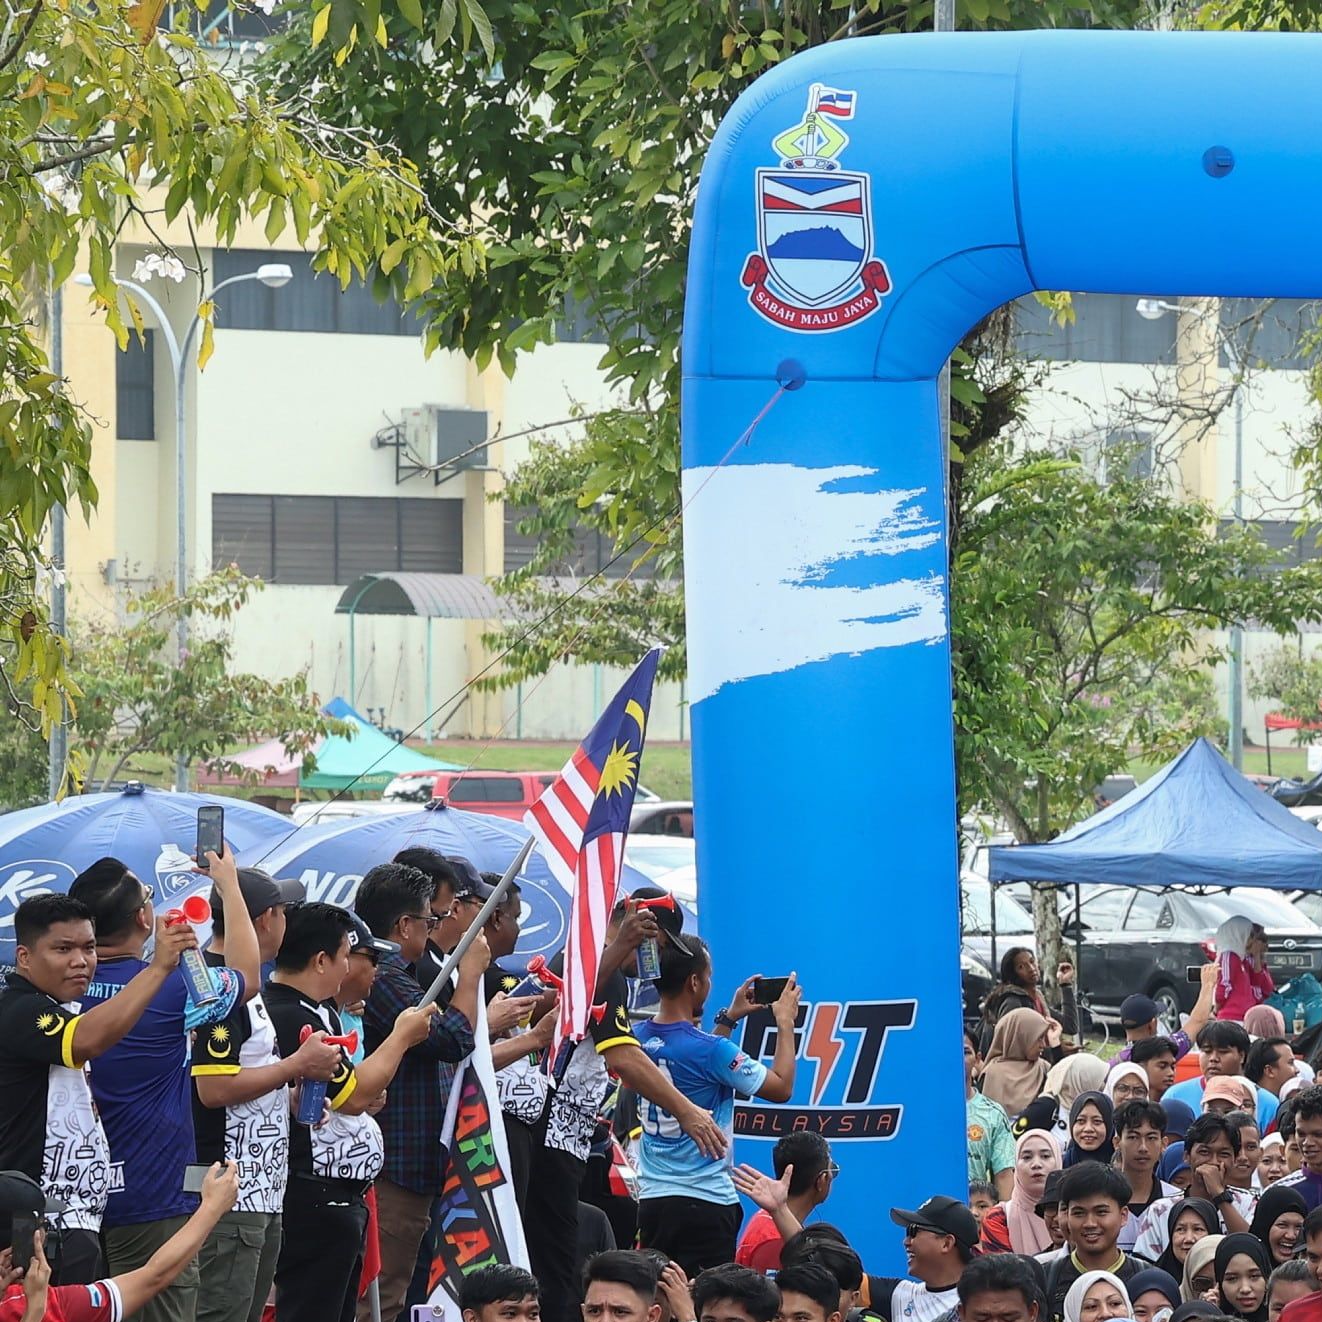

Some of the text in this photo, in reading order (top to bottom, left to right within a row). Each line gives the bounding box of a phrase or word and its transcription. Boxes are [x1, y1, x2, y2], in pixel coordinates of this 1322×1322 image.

[755, 291, 873, 325] SABAH MAJU JAYA
[735, 1111, 893, 1133] MALAYSIA
